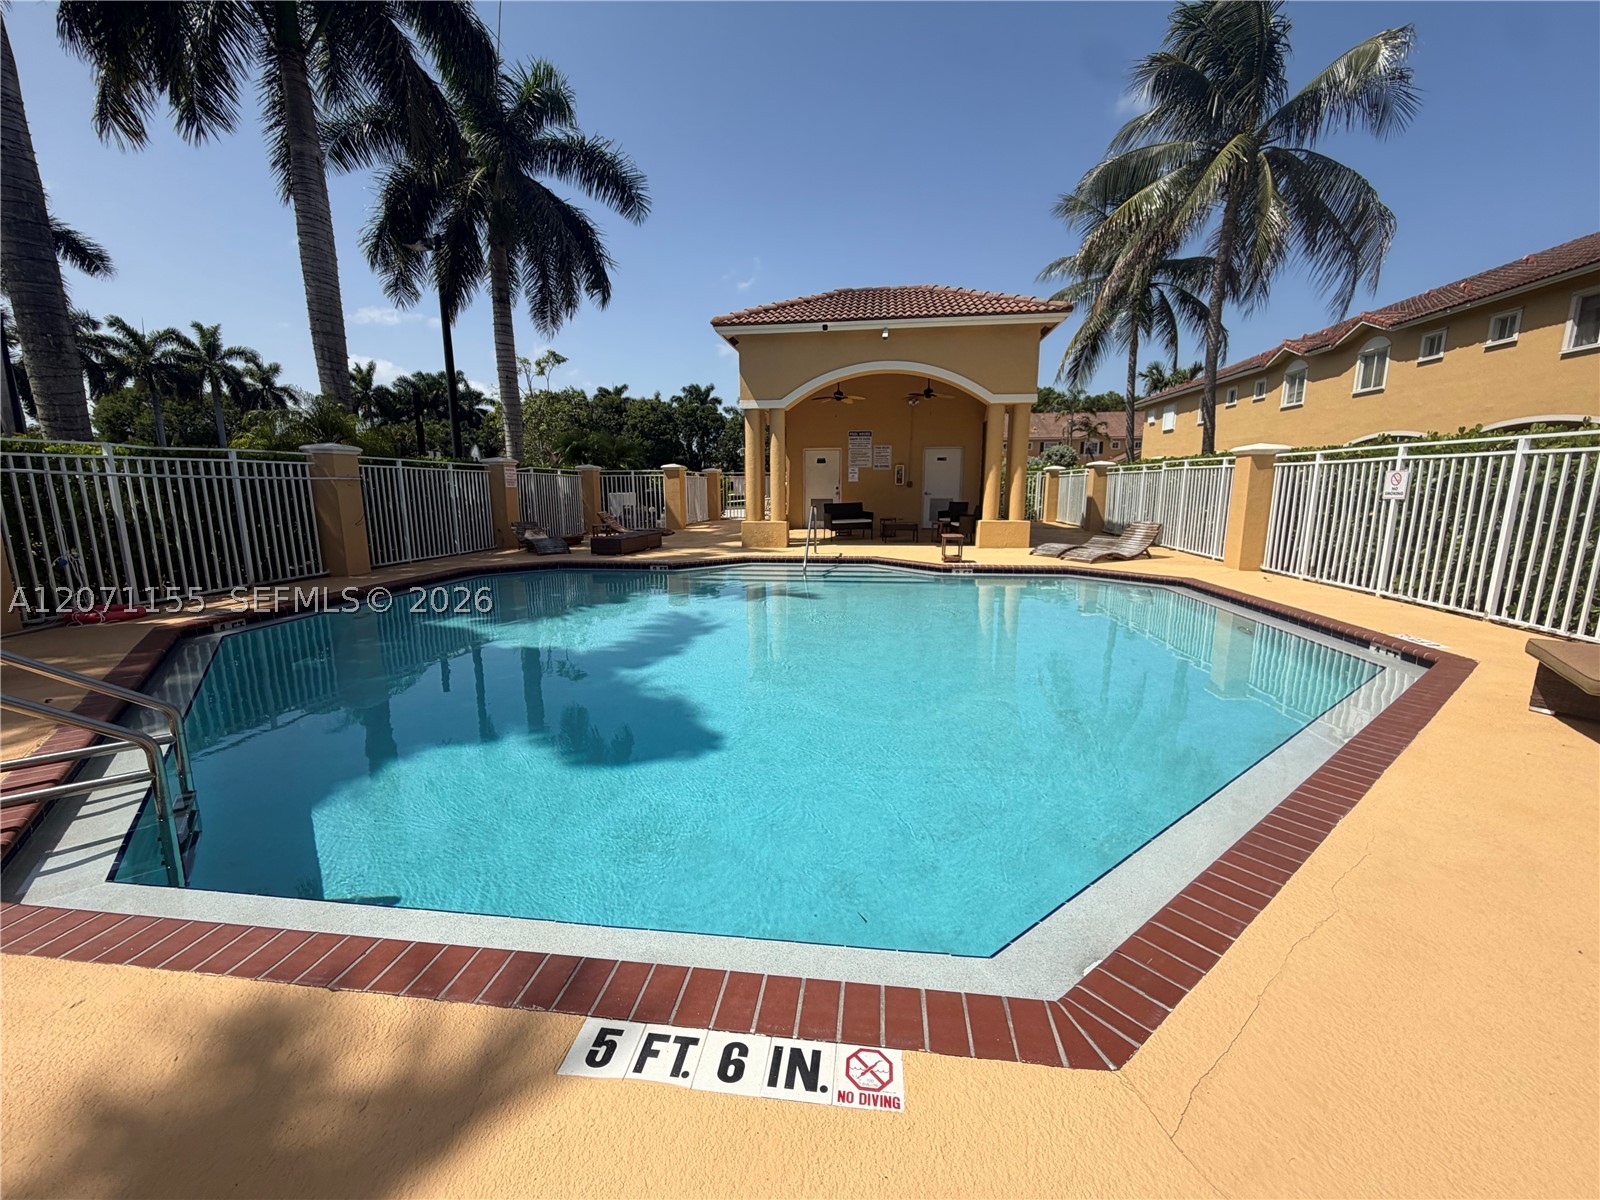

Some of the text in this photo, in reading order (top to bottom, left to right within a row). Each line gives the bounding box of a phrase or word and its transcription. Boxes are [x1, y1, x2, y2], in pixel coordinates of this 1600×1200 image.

[584, 1027, 829, 1093] 5 FT. 6 IN.
[837, 1090, 901, 1110] NO DIVING
